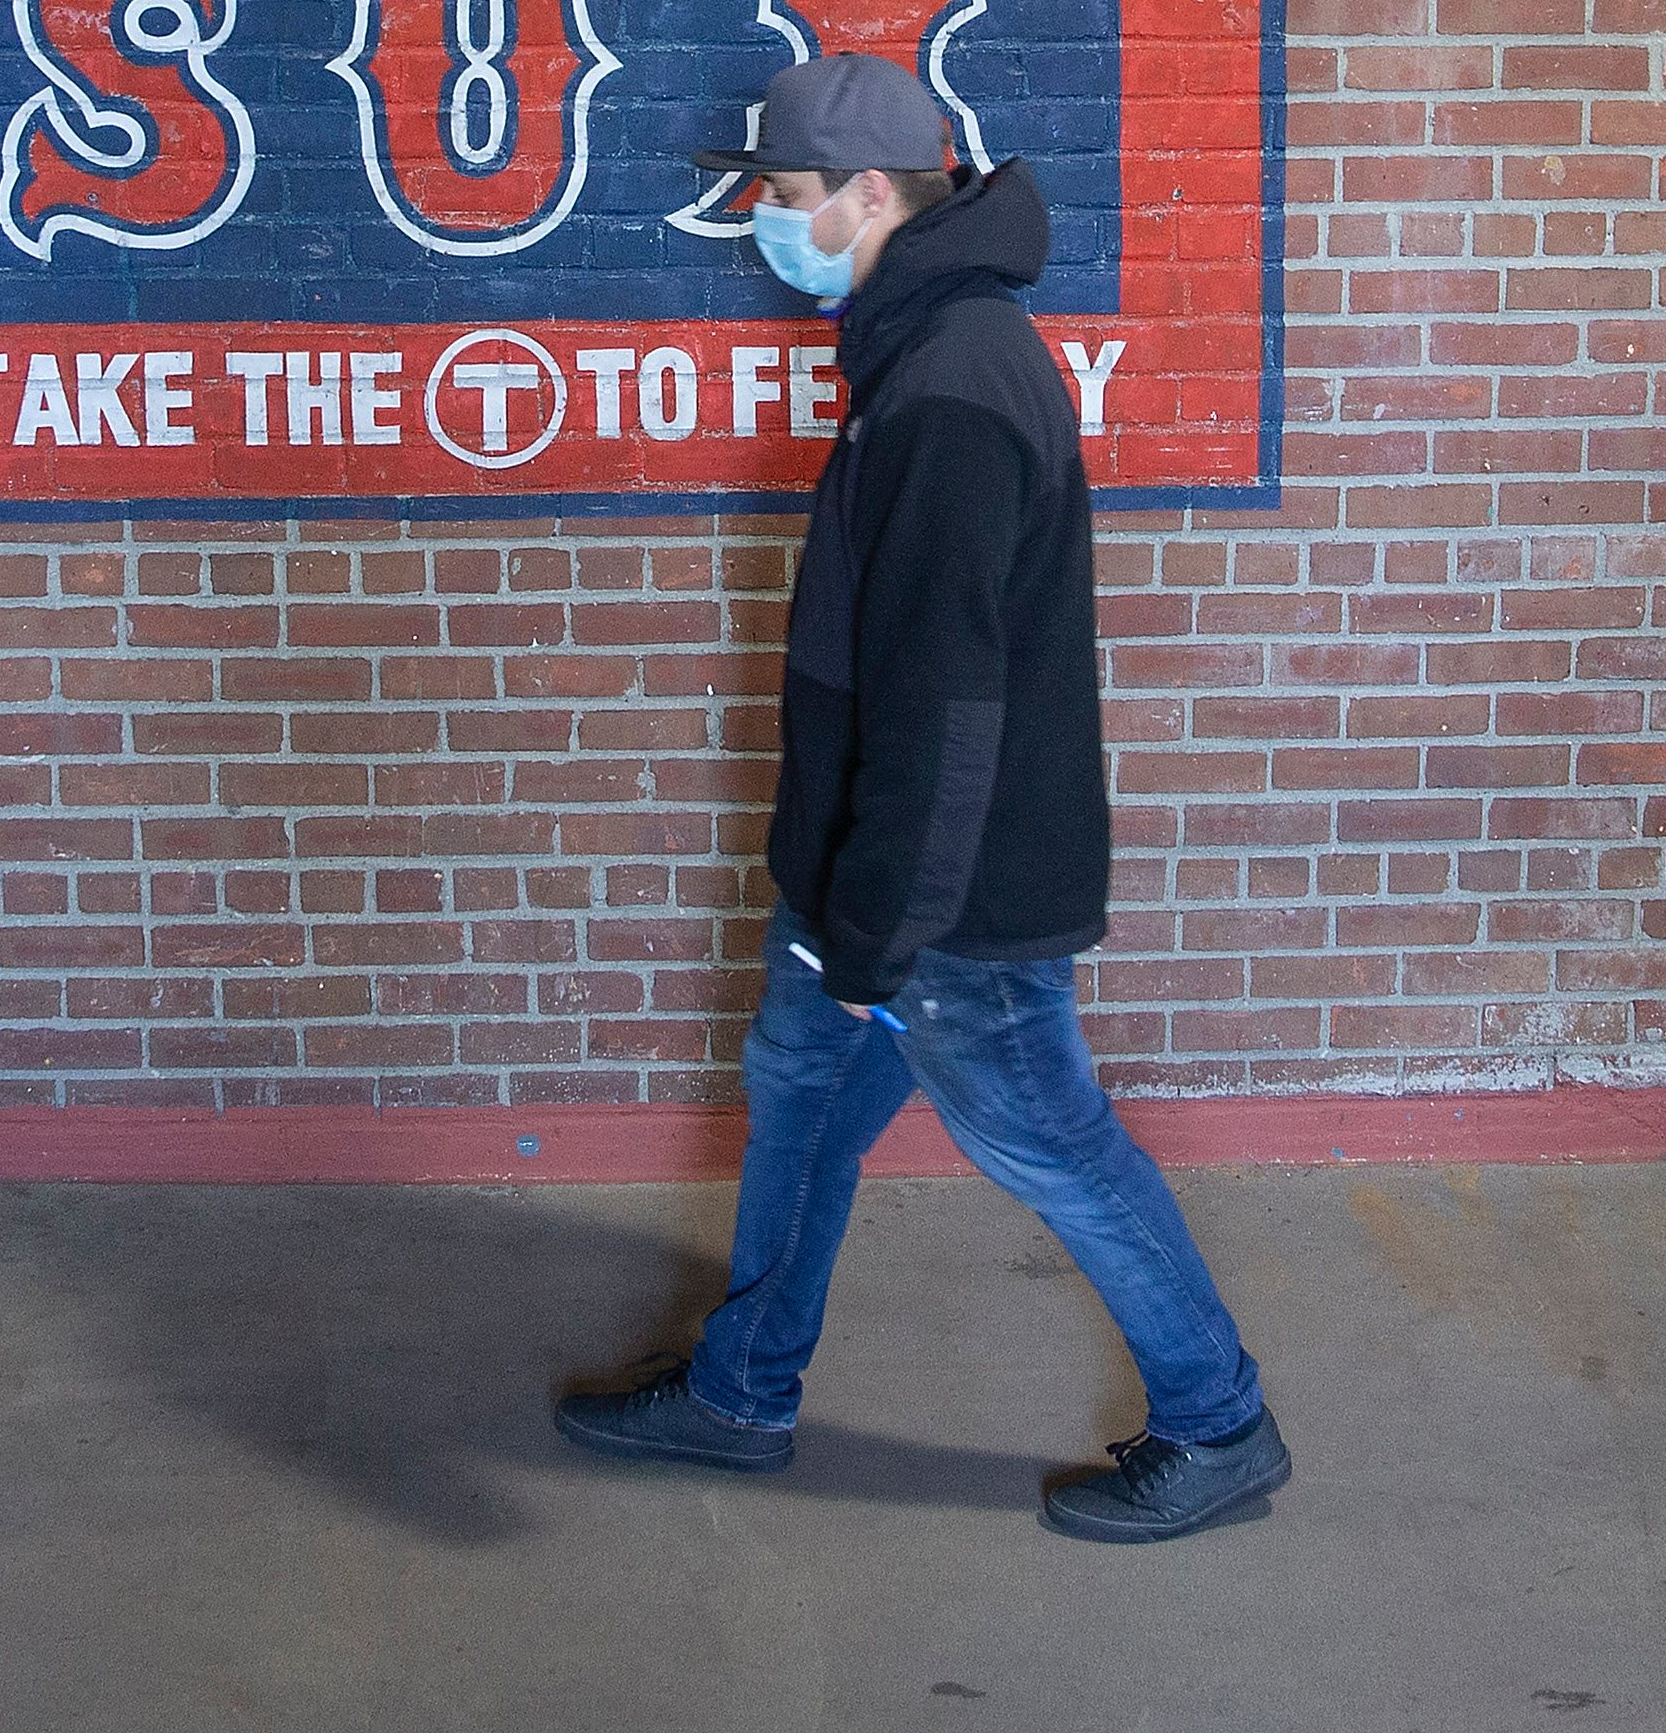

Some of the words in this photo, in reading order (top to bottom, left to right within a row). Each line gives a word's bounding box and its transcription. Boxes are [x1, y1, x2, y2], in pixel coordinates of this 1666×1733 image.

[225, 350, 403, 447] THE
[576, 346, 698, 442] TO
[731, 339, 1128, 439] FEY
